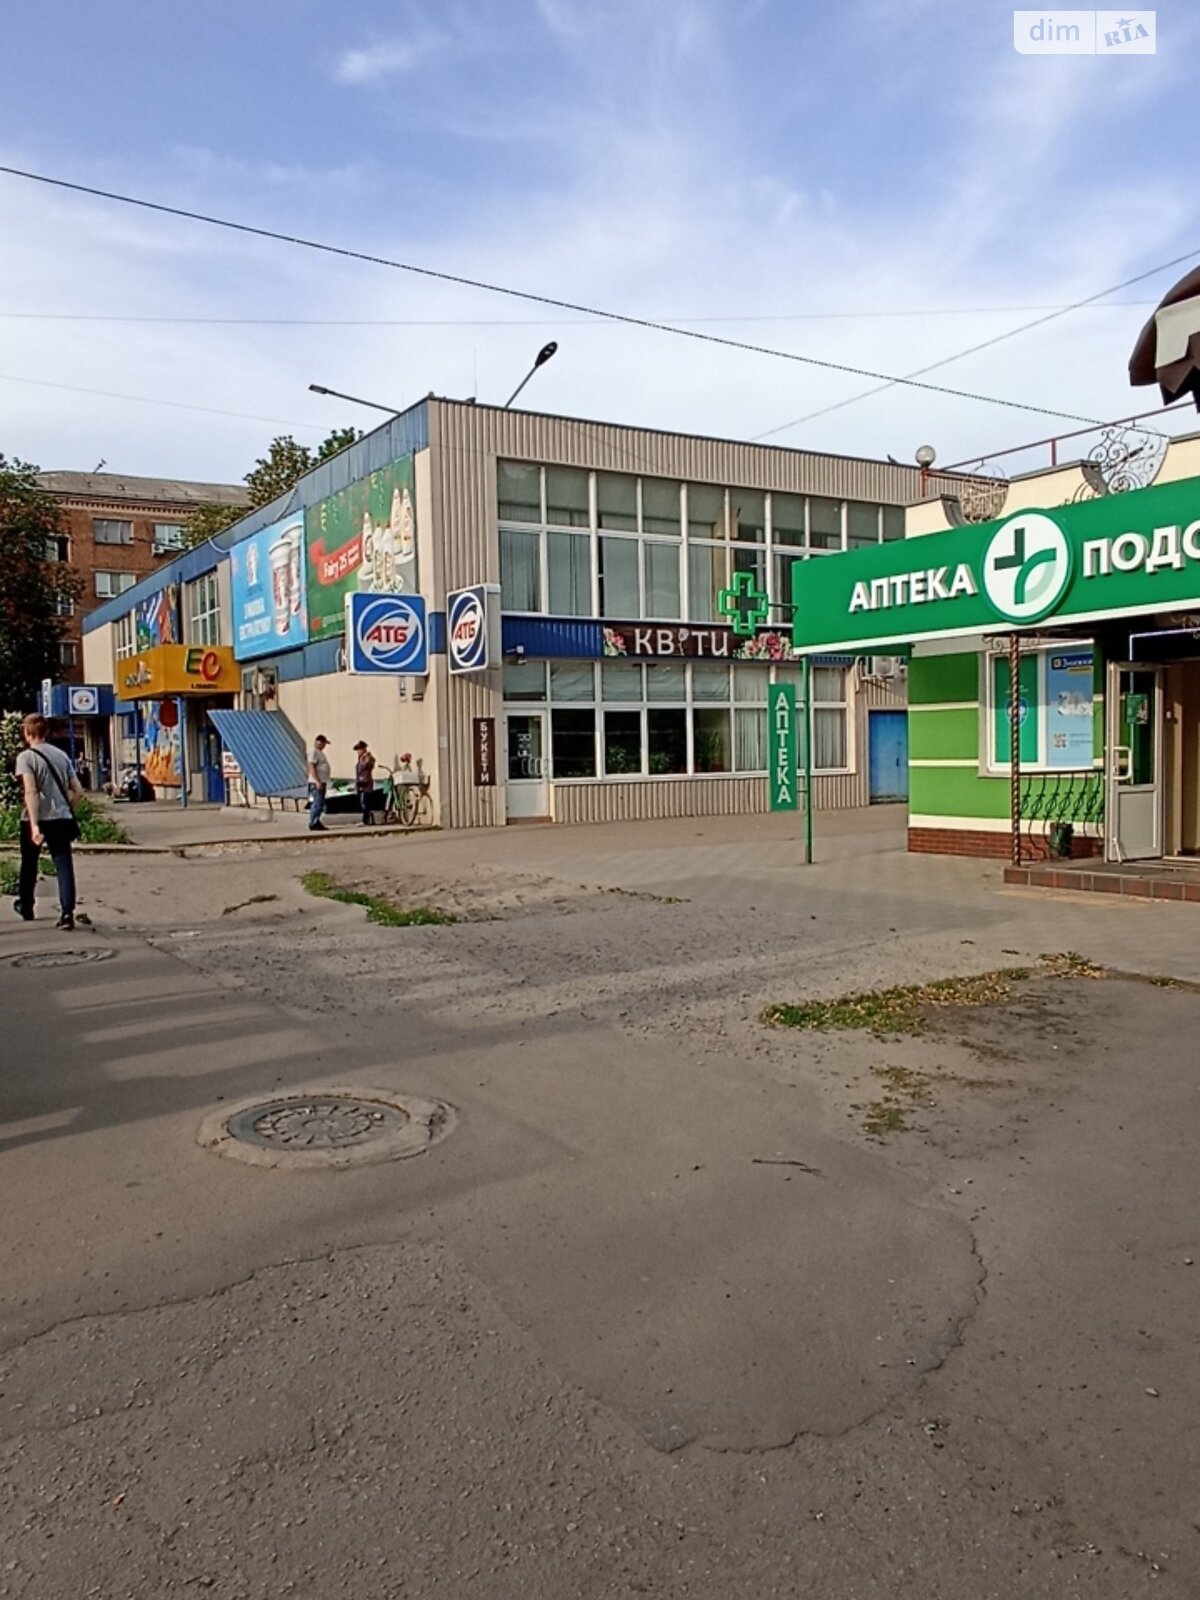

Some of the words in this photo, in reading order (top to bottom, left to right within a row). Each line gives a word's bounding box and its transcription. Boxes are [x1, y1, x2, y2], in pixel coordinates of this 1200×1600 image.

[848, 562, 978, 614] АПТЕКА
[366, 626, 409, 643] АТБ
[454, 619, 476, 640] АТБ
[480, 721, 490, 783] БУКЕТИ
[775, 691, 791, 803] АПТЕКА
